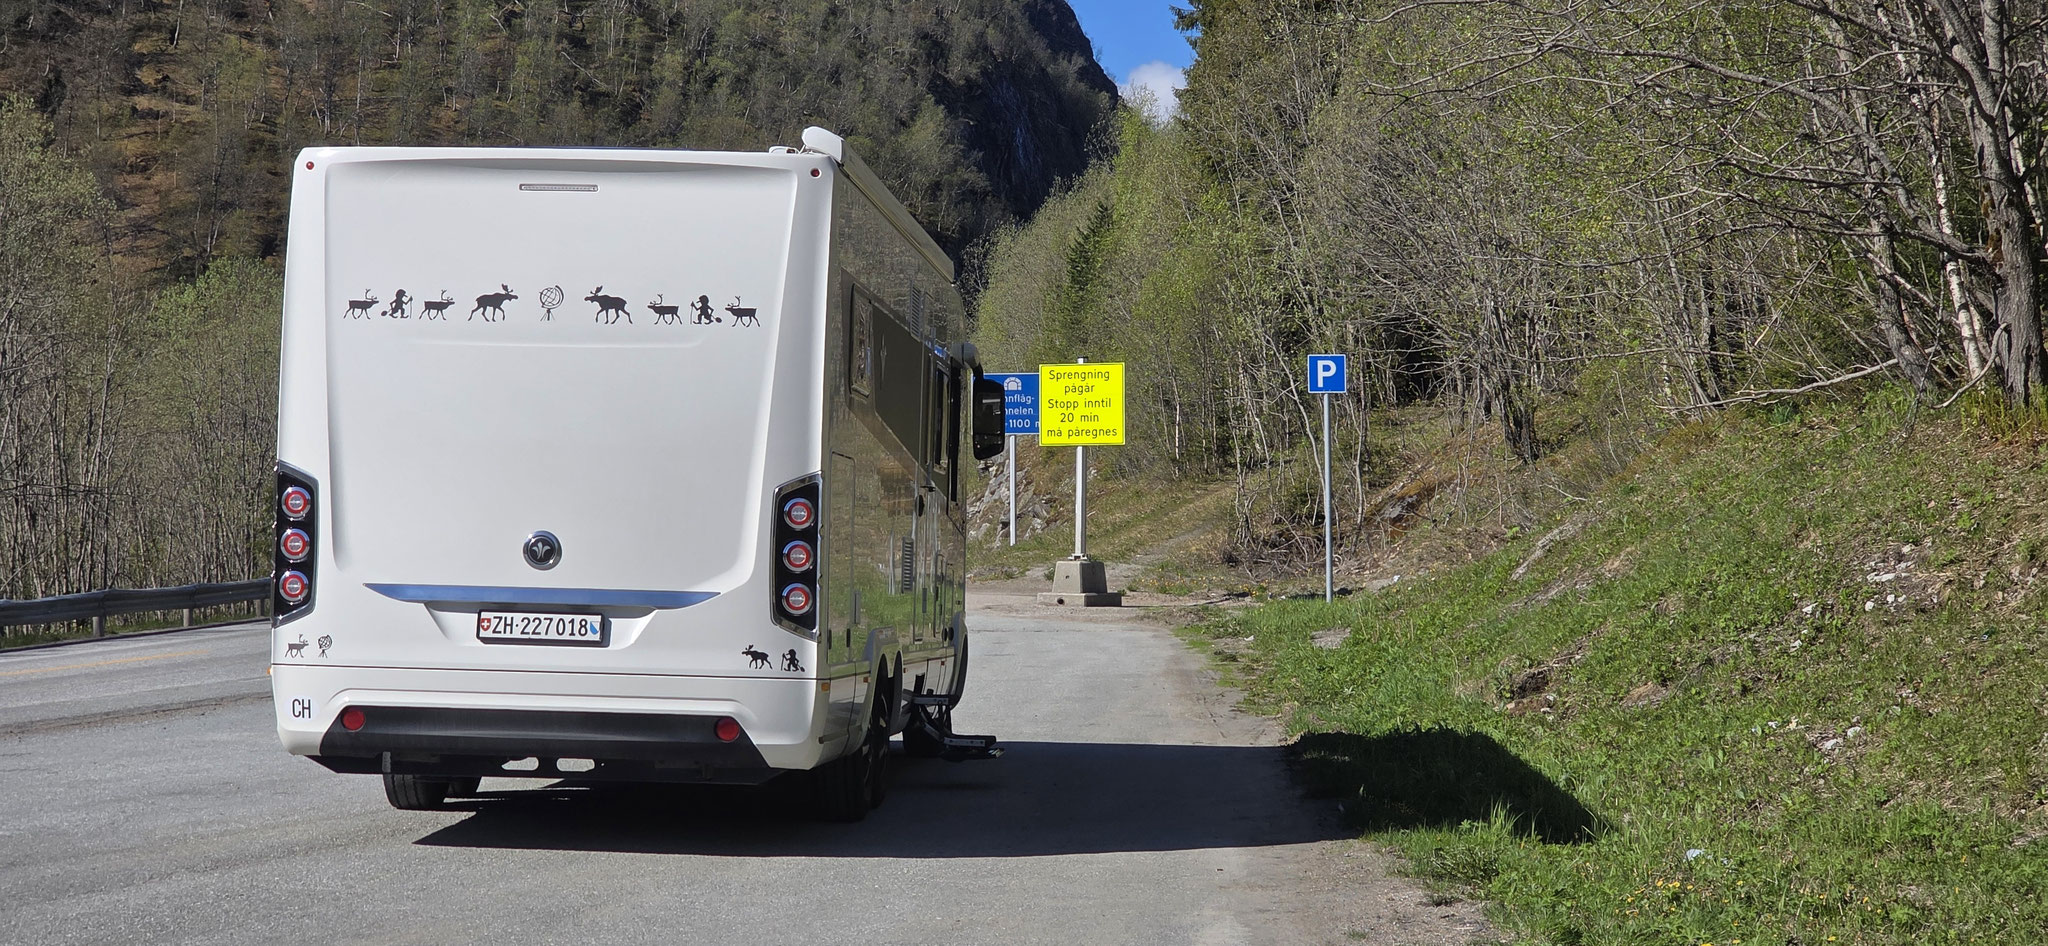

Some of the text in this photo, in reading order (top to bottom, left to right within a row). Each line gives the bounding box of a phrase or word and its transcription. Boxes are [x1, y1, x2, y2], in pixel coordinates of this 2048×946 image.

[1049, 369, 1110, 382] Sprengning
[1317, 360, 1337, 388] P
[1064, 383, 1095, 395] pågår
[1048, 398, 1112, 410] Stopp inntil
[1060, 413, 1099, 423] 20 min
[1047, 426, 1118, 439] må påregnes
[292, 698, 311, 719] CH
